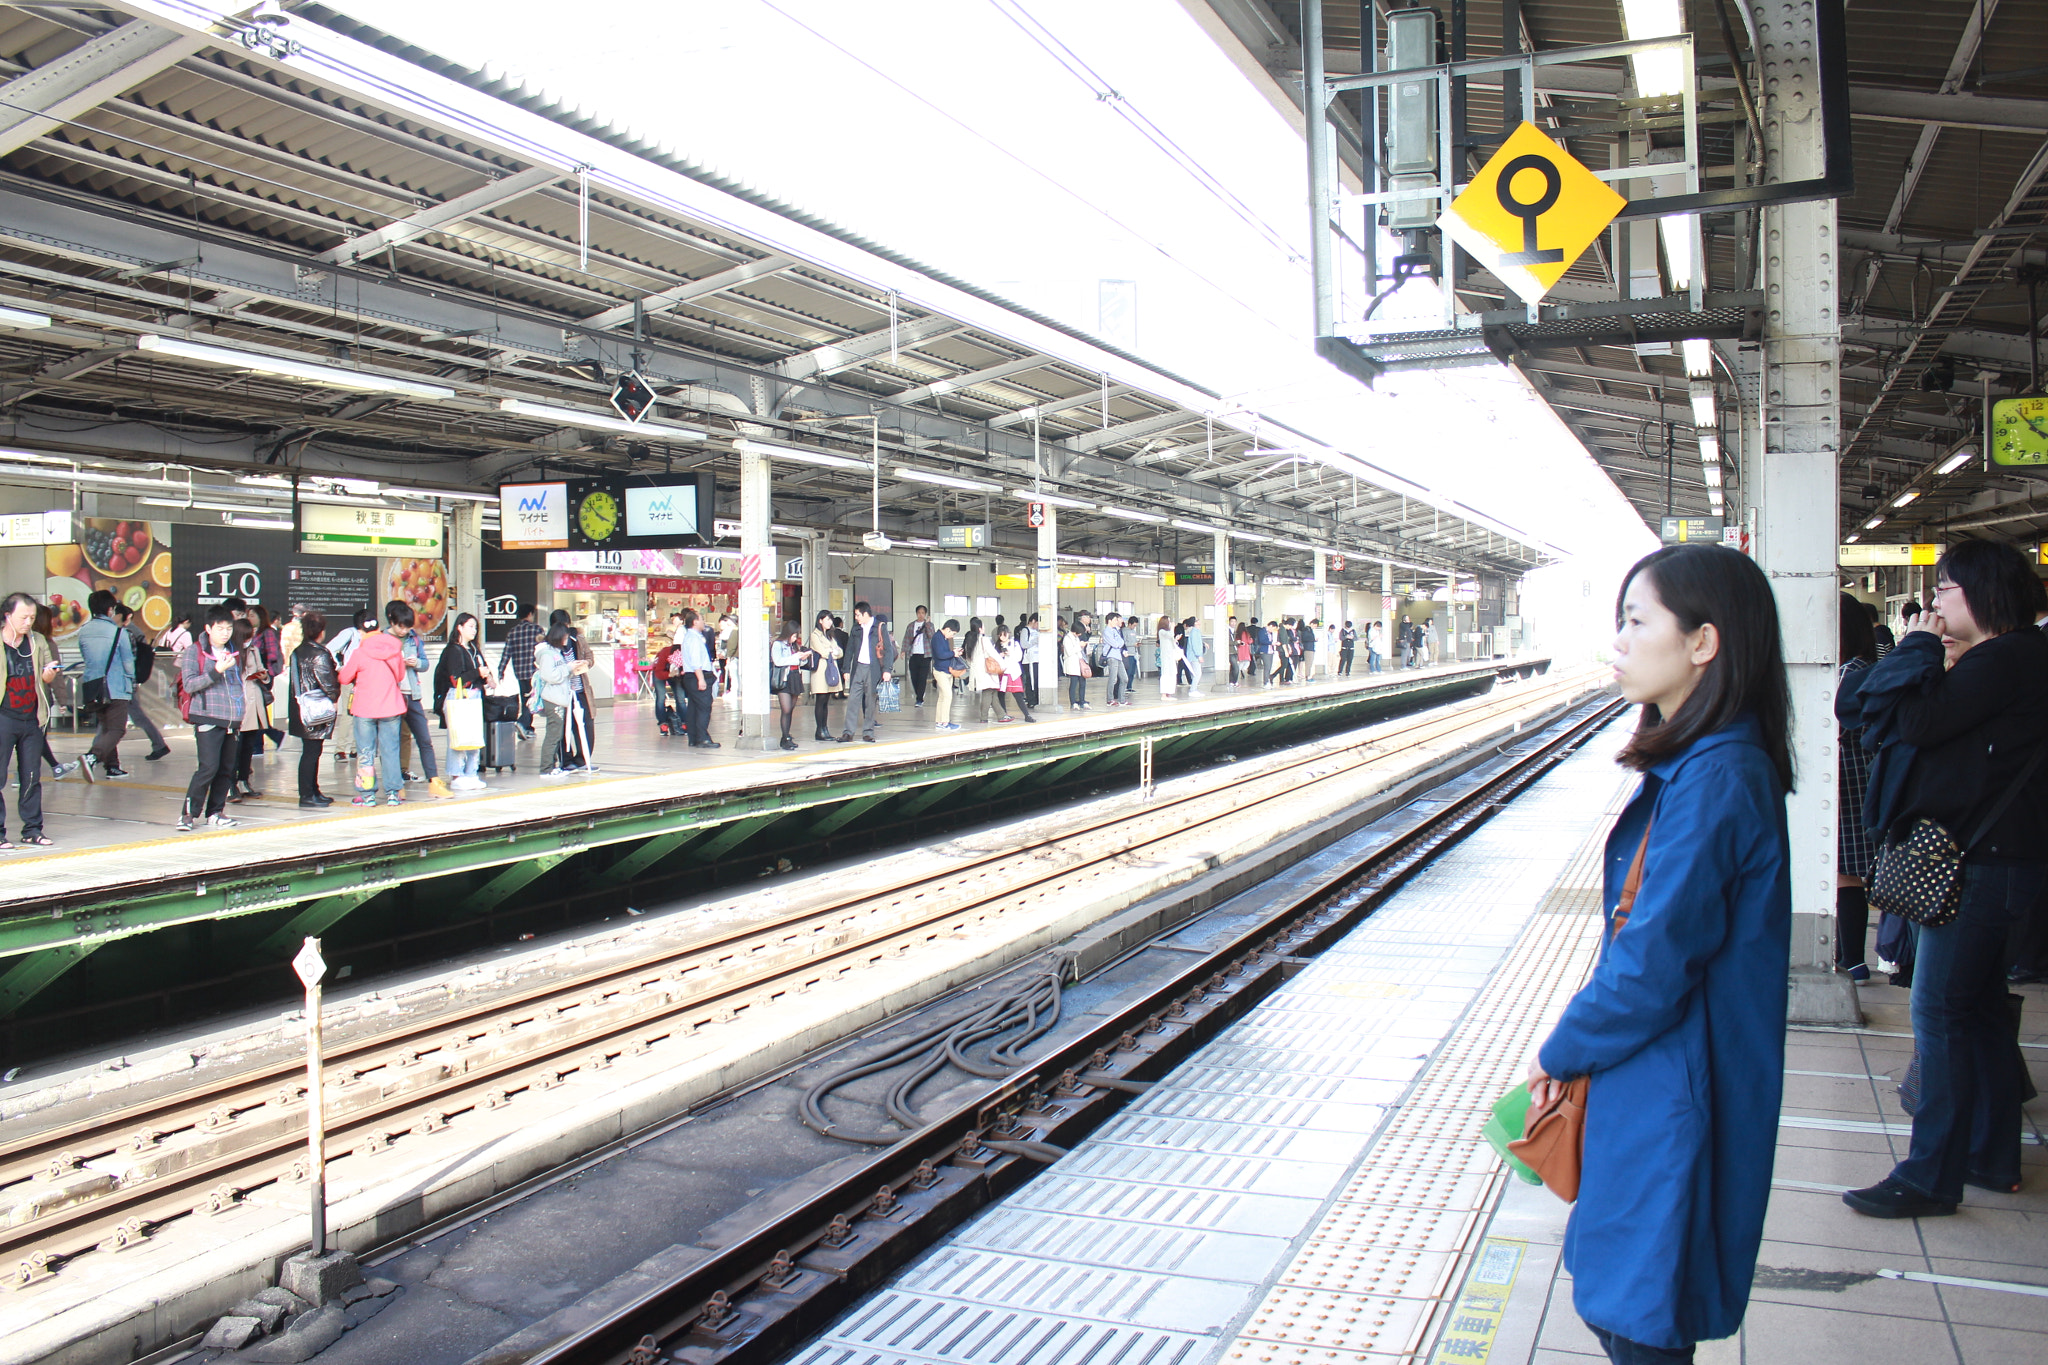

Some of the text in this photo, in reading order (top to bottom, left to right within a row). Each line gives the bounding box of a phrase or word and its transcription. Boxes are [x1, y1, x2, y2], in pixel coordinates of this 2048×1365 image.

[2031, 402, 2044, 411] 12
[2005, 416, 2018, 425] 10
[2000, 428, 2008, 437] 9
[2005, 442, 2014, 451] 8
[2018, 450, 2026, 458] 7
[2032, 452, 2041, 460] 6
[356, 510, 395, 526] 秋葉原
[519, 513, 548, 523] マイナビ
[649, 512, 673, 521] マイナビ
[1033, 515, 1041, 524] 5
[1666, 520, 1678, 537] 5
[972, 527, 982, 543] 6
[196, 563, 260, 598] FLO
[485, 594, 517, 614] FLO
[304, 954, 315, 978] 6
[1439, 1294, 1505, 1365] 乗車口
